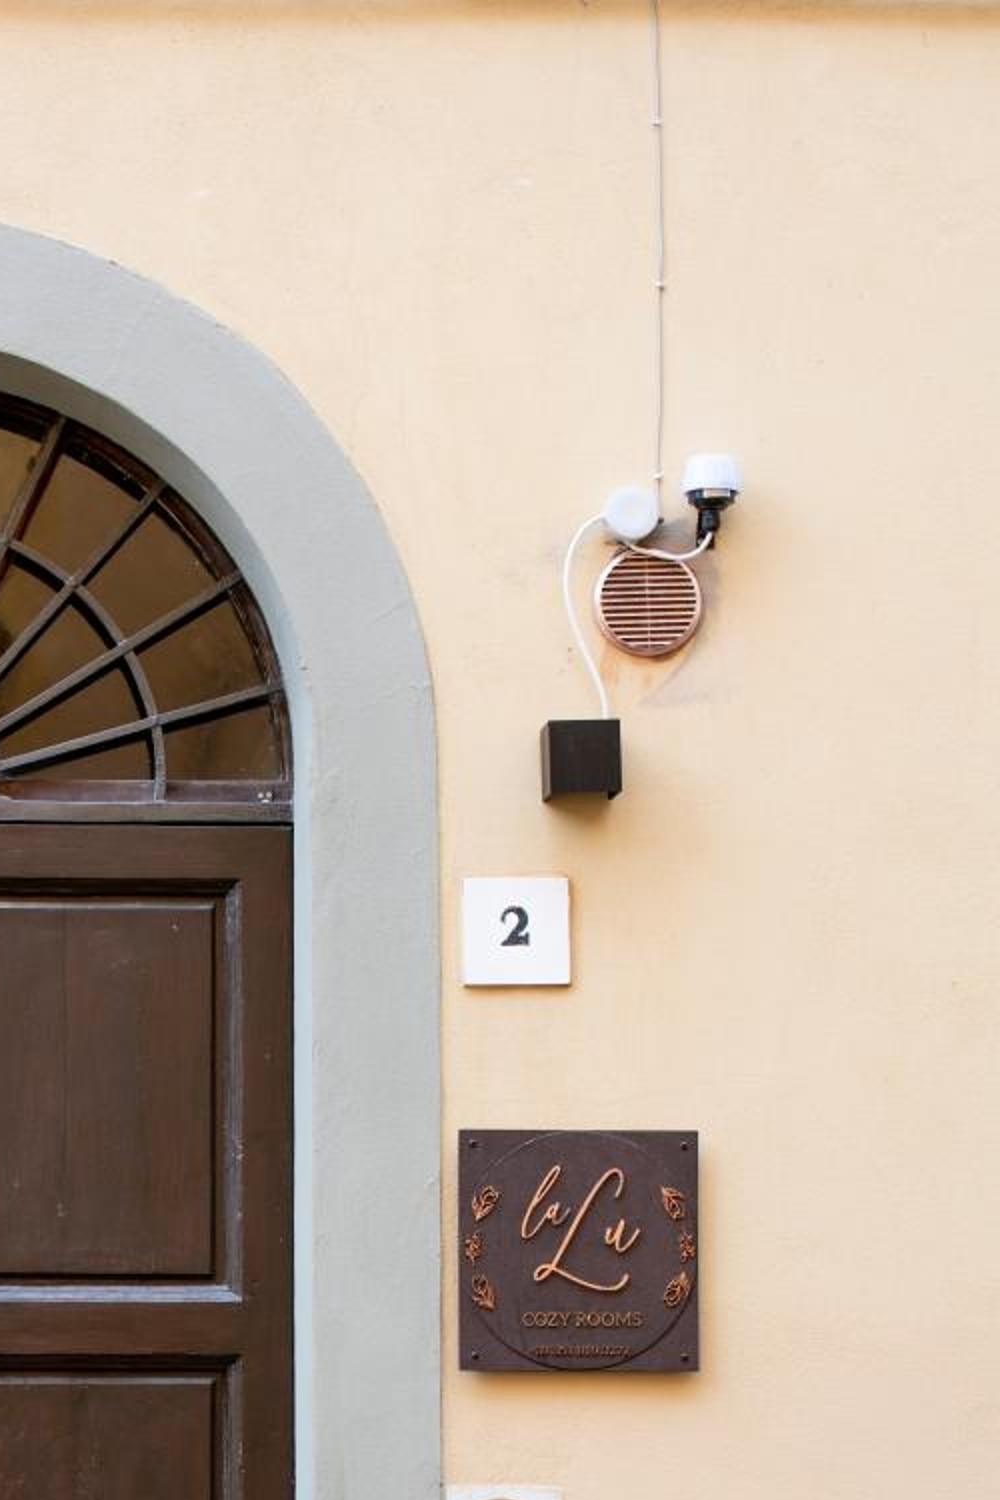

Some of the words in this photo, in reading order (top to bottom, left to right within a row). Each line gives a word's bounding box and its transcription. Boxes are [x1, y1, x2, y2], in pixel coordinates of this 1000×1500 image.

[500, 905, 530, 947] 2
[533, 1167, 641, 1292] Lu
[521, 1311, 570, 1328] COZY
[575, 1311, 642, 1328] ROOMS
